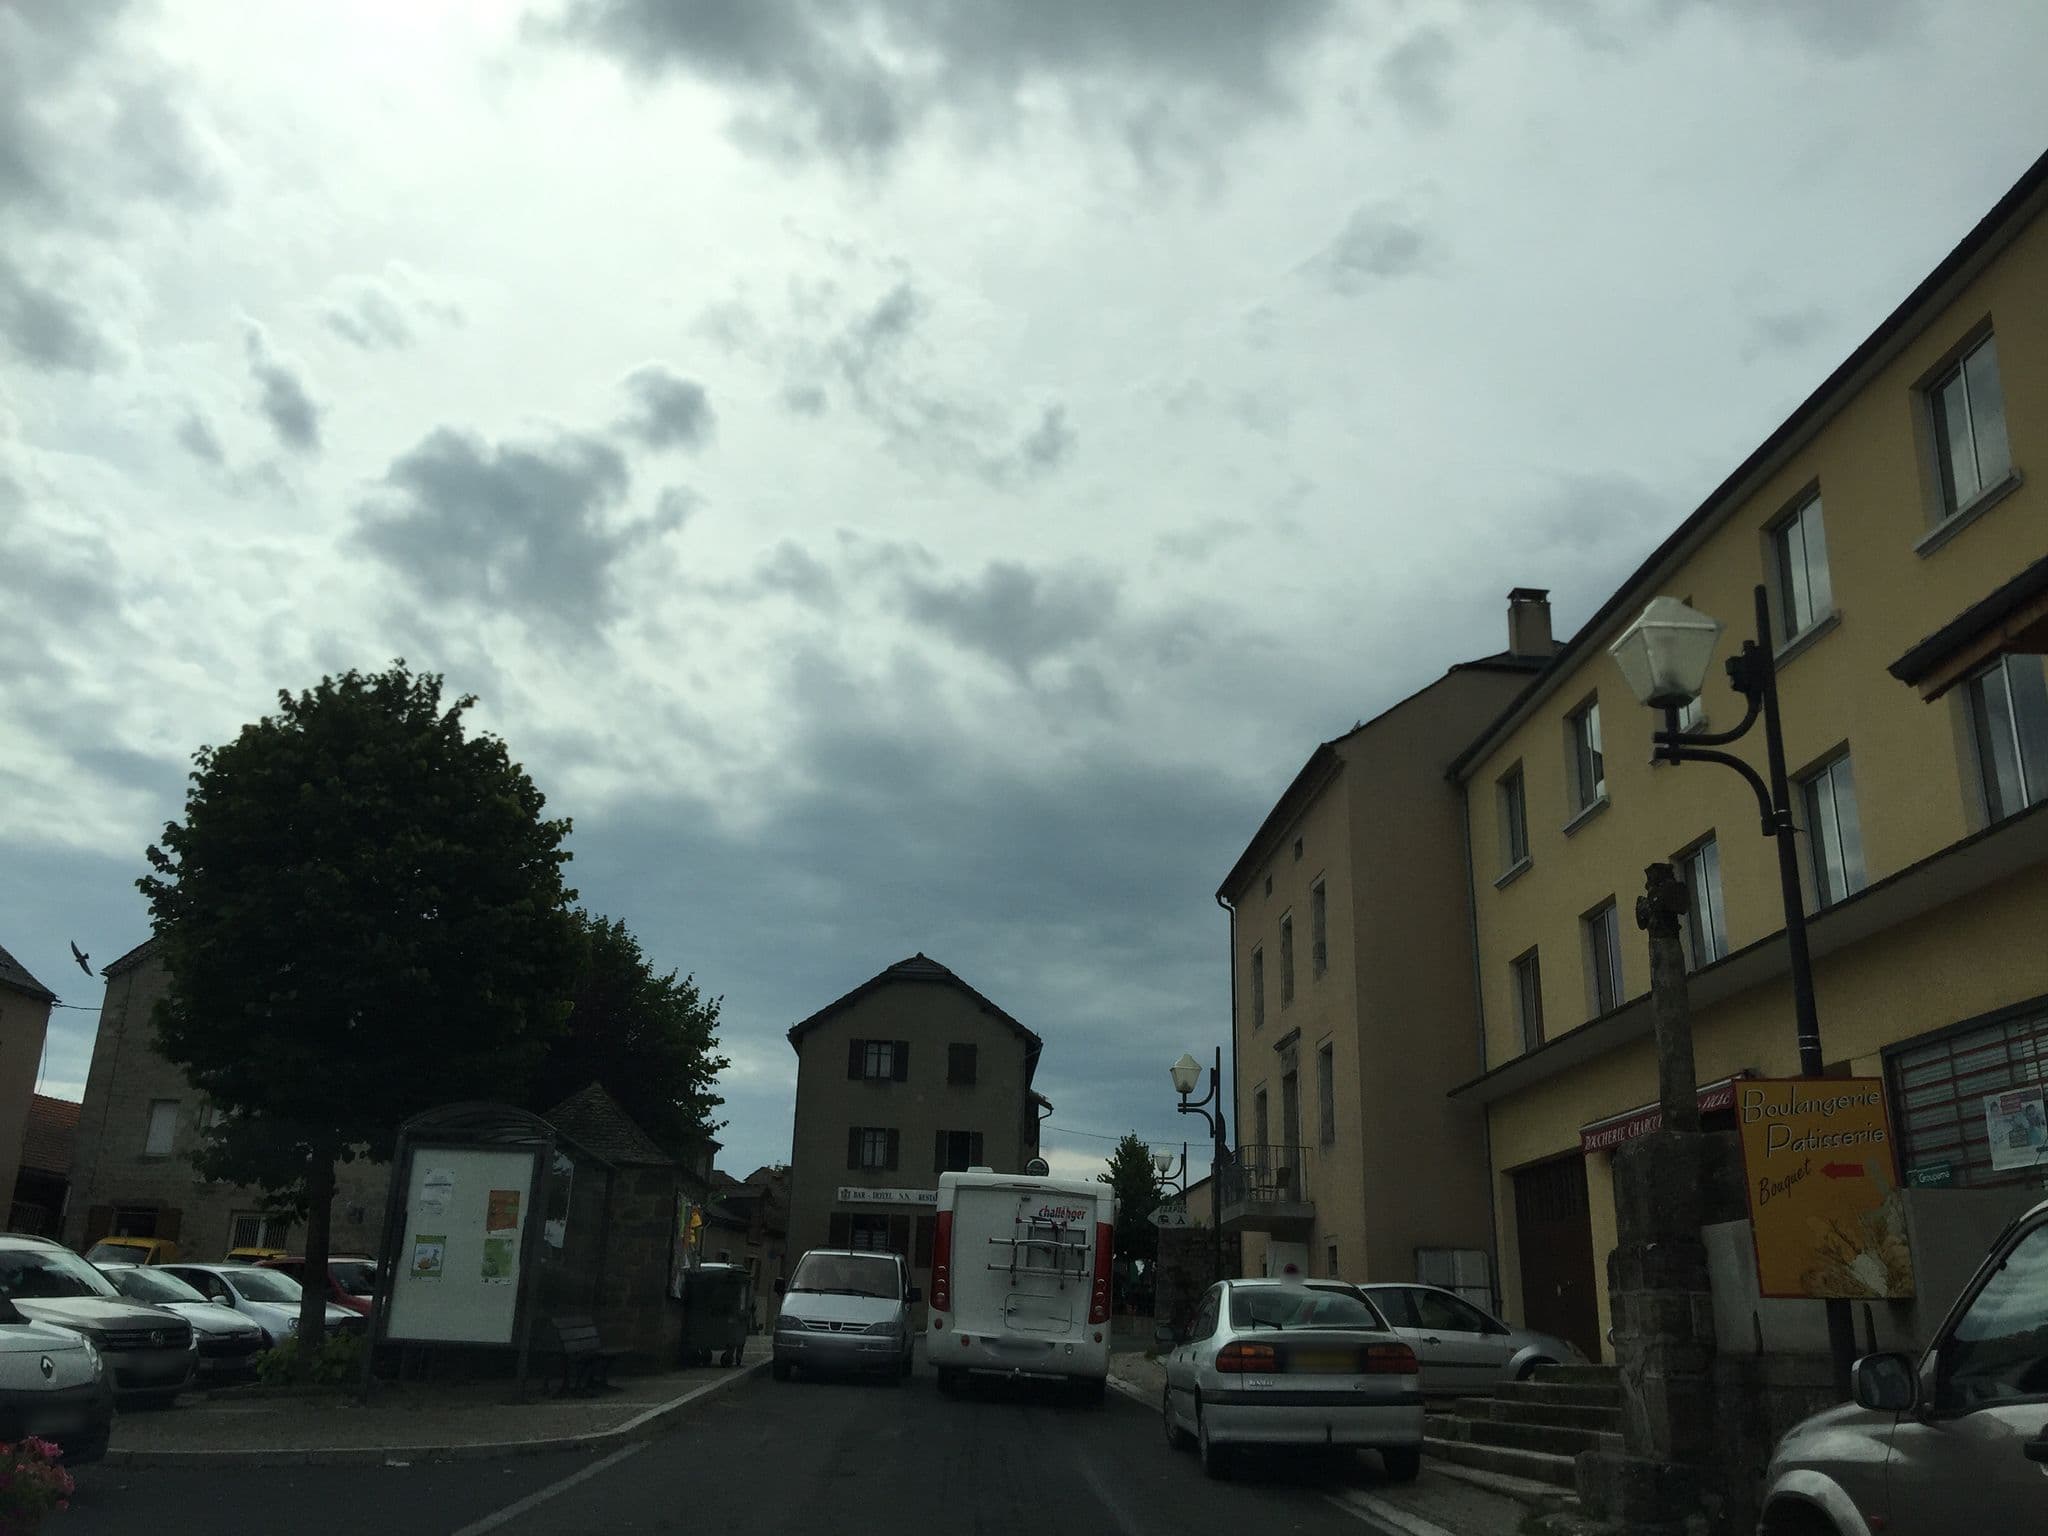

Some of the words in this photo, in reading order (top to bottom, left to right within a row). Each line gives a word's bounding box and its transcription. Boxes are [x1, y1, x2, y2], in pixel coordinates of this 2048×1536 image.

[1743, 1086, 1881, 1124] Boulangerie
[1766, 1122, 1886, 1160] Patisserie
[1758, 1155, 1811, 1207] Bouquet
[1038, 1204, 1087, 1222] challenger
